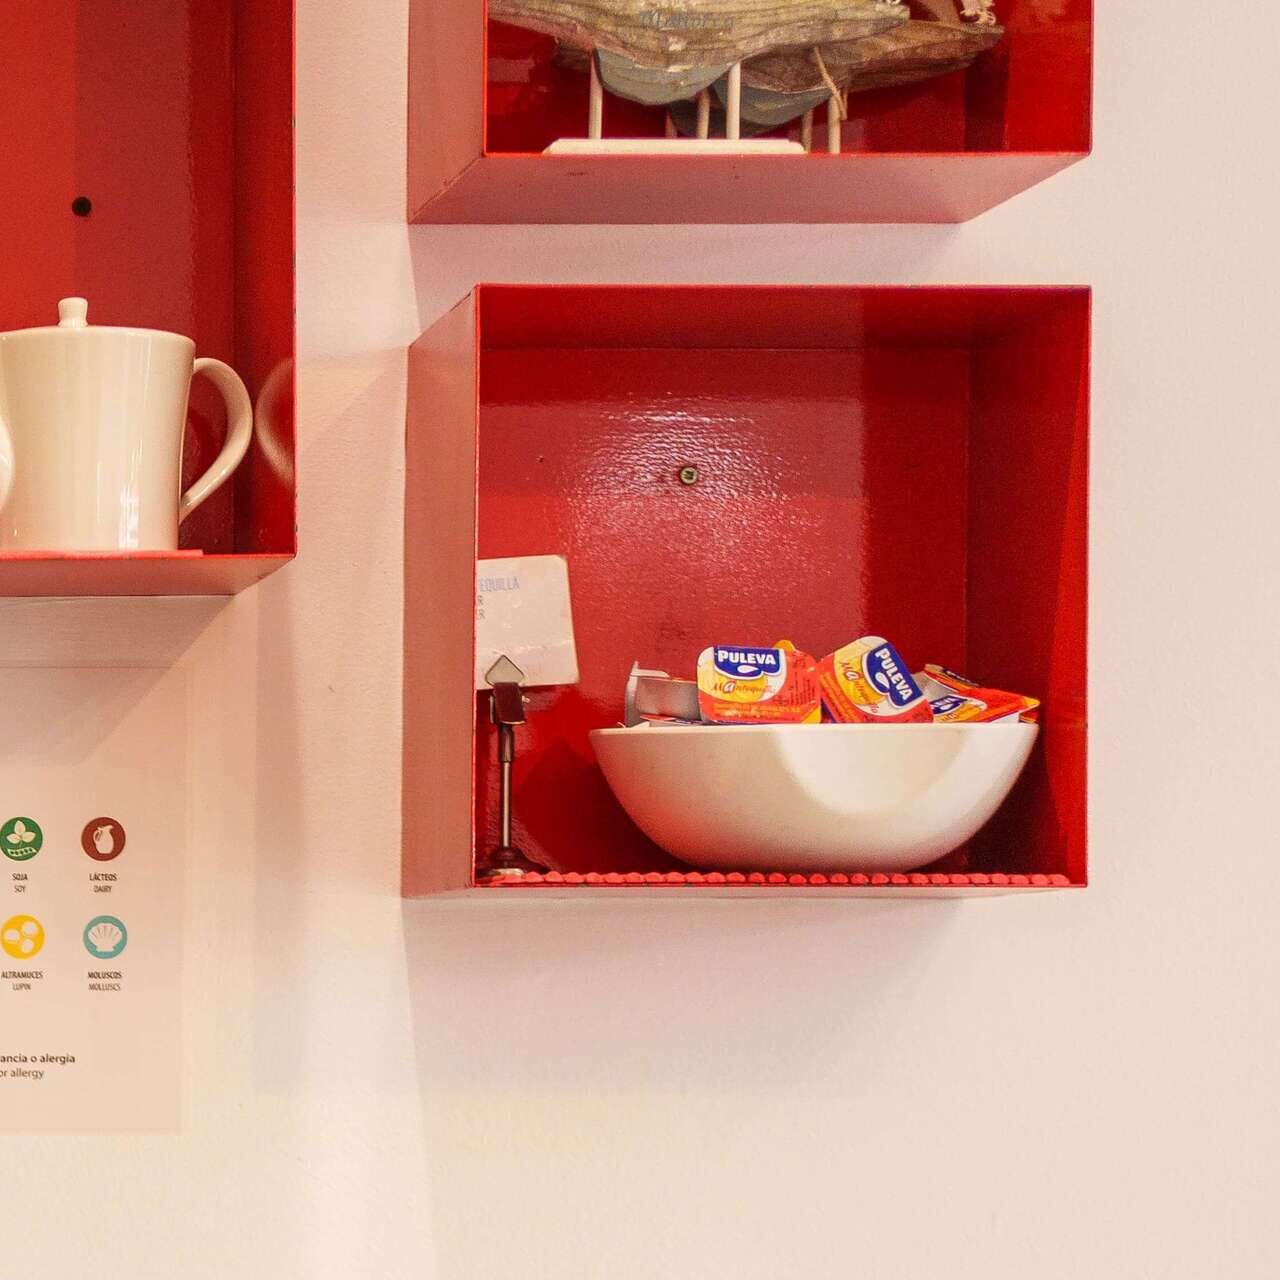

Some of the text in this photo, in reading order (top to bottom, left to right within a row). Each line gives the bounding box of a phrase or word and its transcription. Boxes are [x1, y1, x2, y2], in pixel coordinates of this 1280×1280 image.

[717, 650, 776, 665] PULEVA
[874, 647, 913, 701] PULEVA
[12, 873, 28, 882] SOJA
[89, 871, 118, 882] LÁCTEOS
[14, 884, 27, 893] SOY
[0, 971, 43, 980] ALTRAMUCES
[87, 971, 122, 980] MOLUSCOS
[39, 1053, 76, 1065] alergia
[10, 1067, 44, 1080] allergy
